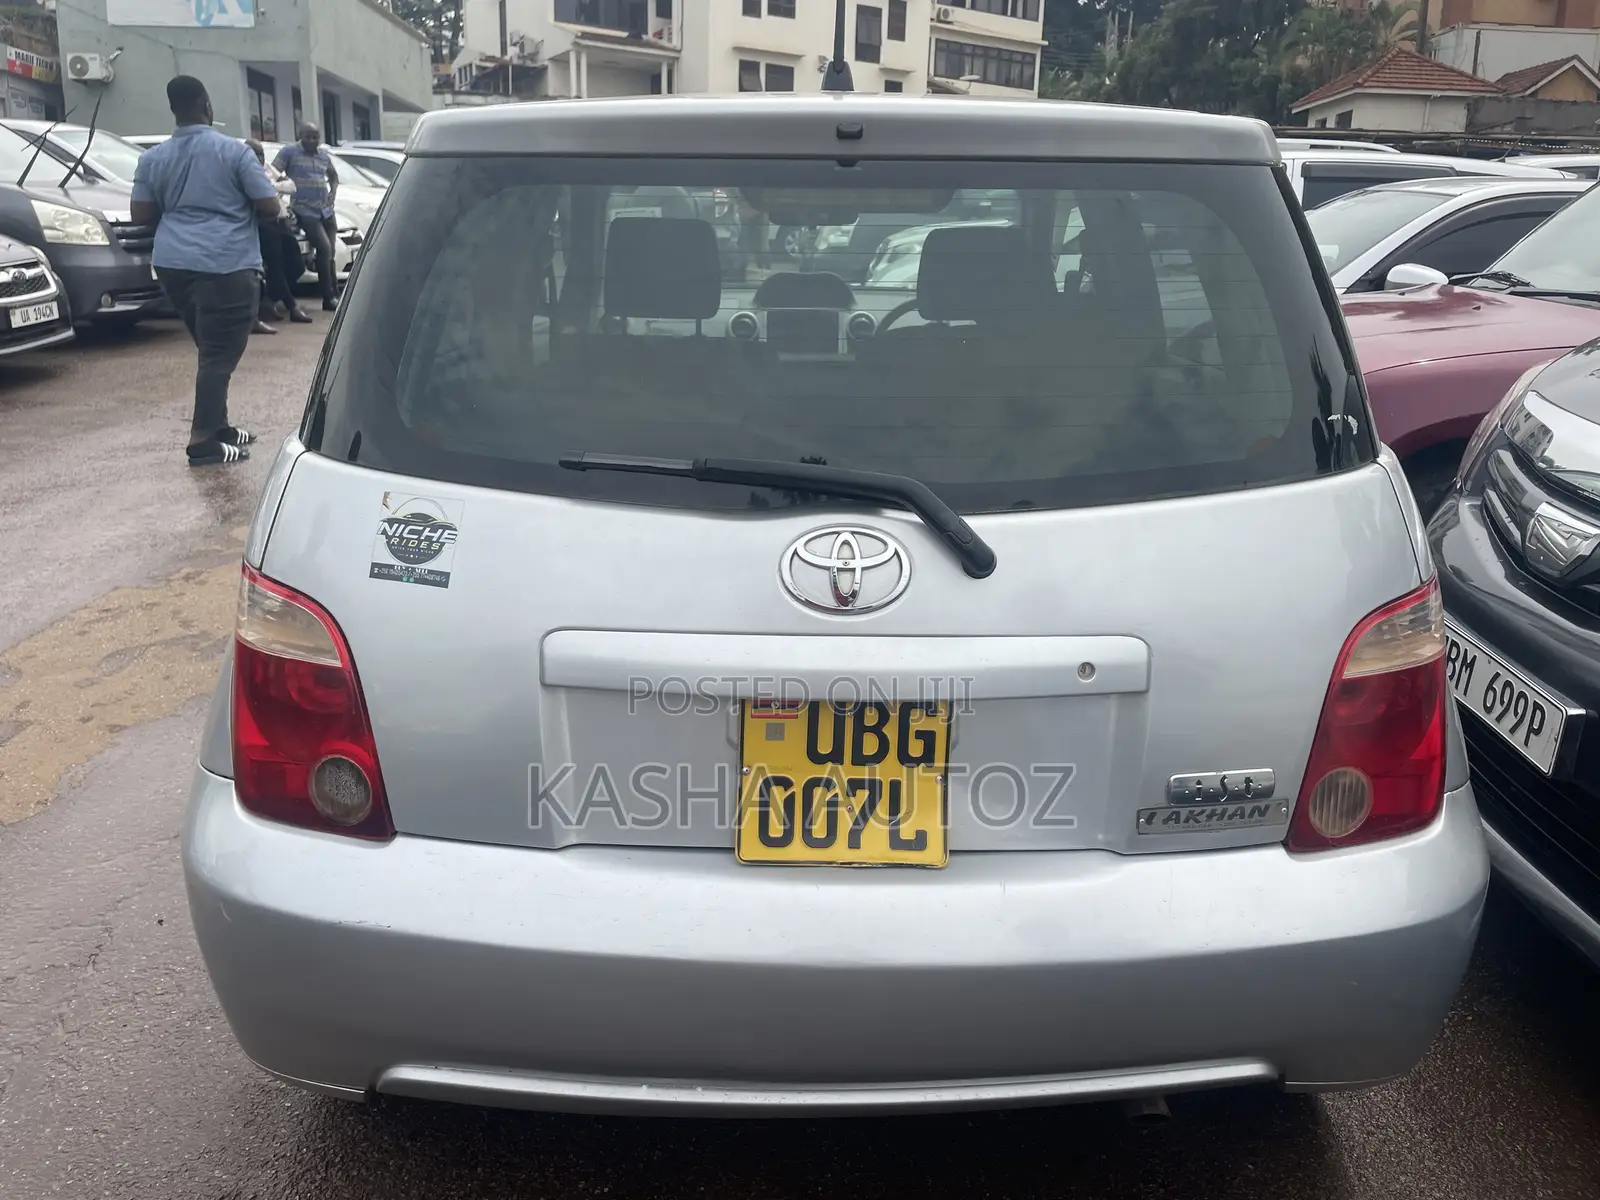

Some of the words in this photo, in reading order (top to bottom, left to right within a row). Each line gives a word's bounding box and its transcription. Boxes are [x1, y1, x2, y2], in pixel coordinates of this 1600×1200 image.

[377, 521, 459, 544] NICHE
[390, 537, 441, 550] RIDES
[1445, 634, 1478, 697] BM
[1482, 671, 1547, 748] 699P
[806, 699, 937, 768] UBG
[758, 775, 928, 851] 007L
